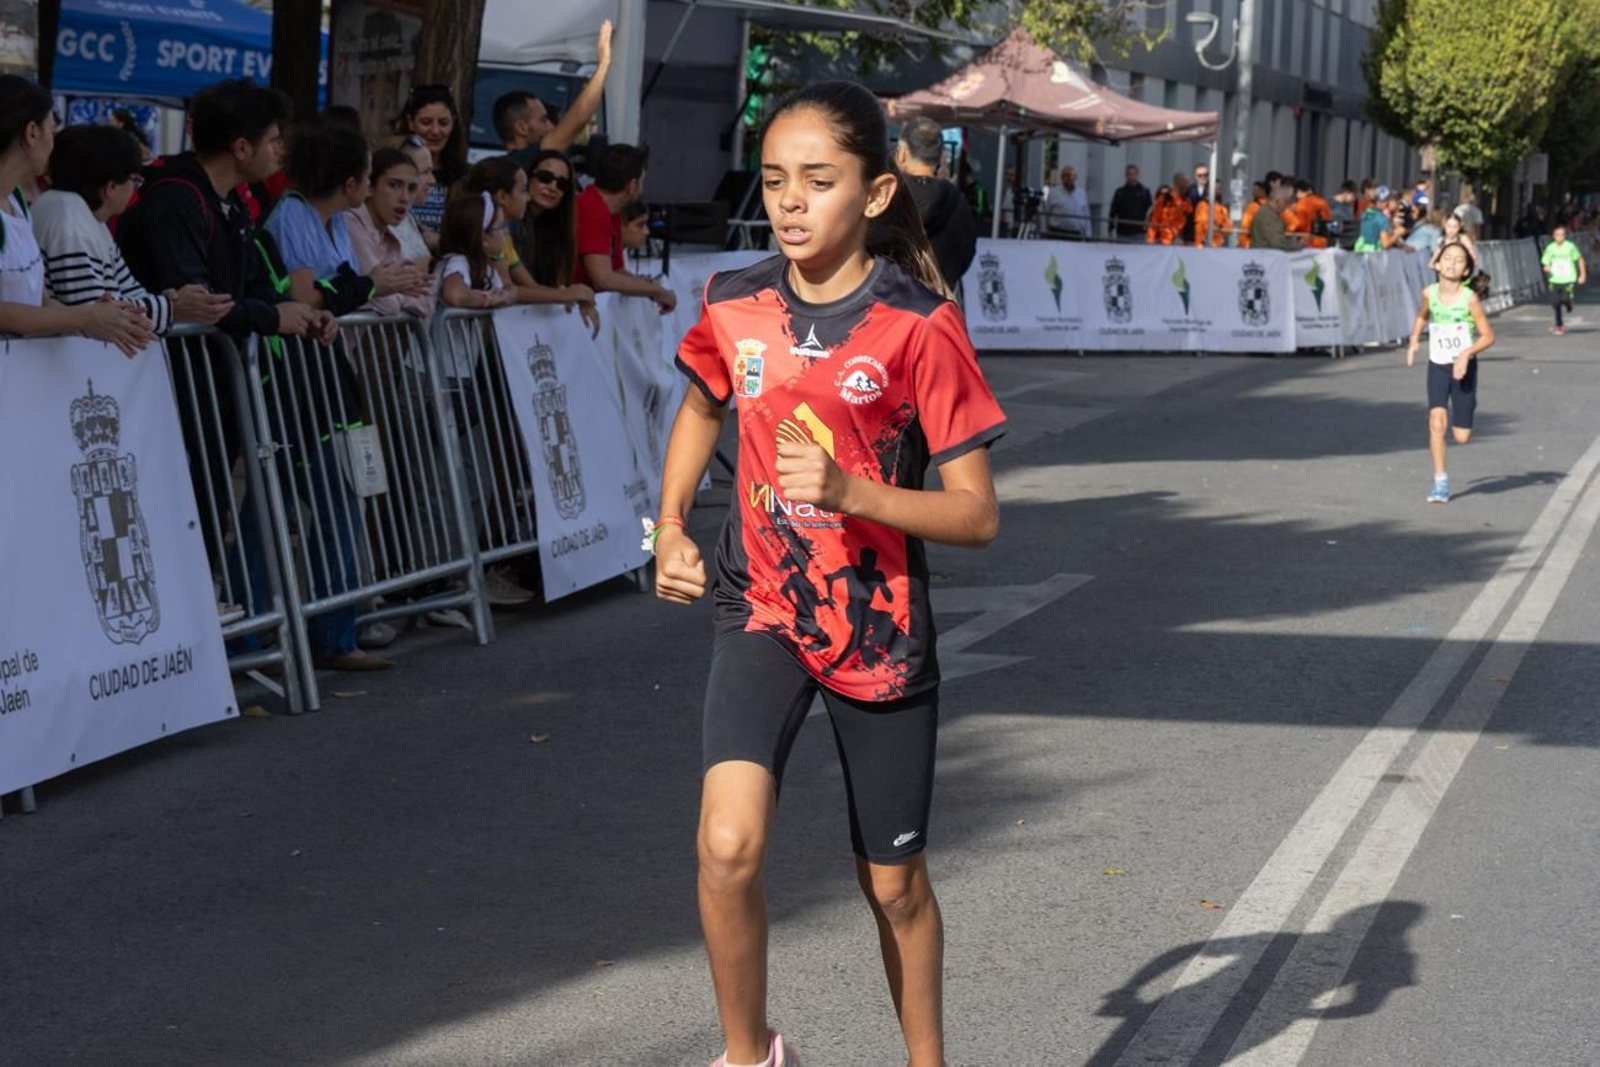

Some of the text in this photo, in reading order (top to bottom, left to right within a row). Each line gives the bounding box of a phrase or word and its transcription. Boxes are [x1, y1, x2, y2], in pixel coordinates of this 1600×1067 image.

[56, 27, 117, 63] GCC
[156, 38, 237, 76] SPORT
[1437, 336, 1462, 350] 130
[838, 386, 884, 405] Martos
[551, 531, 578, 559] CIUDAD
[579, 527, 591, 548] DE
[23, 649, 39, 673] de
[89, 643, 193, 701] CIUDAD DE JAÉN
[0, 683, 31, 715] Jaén
